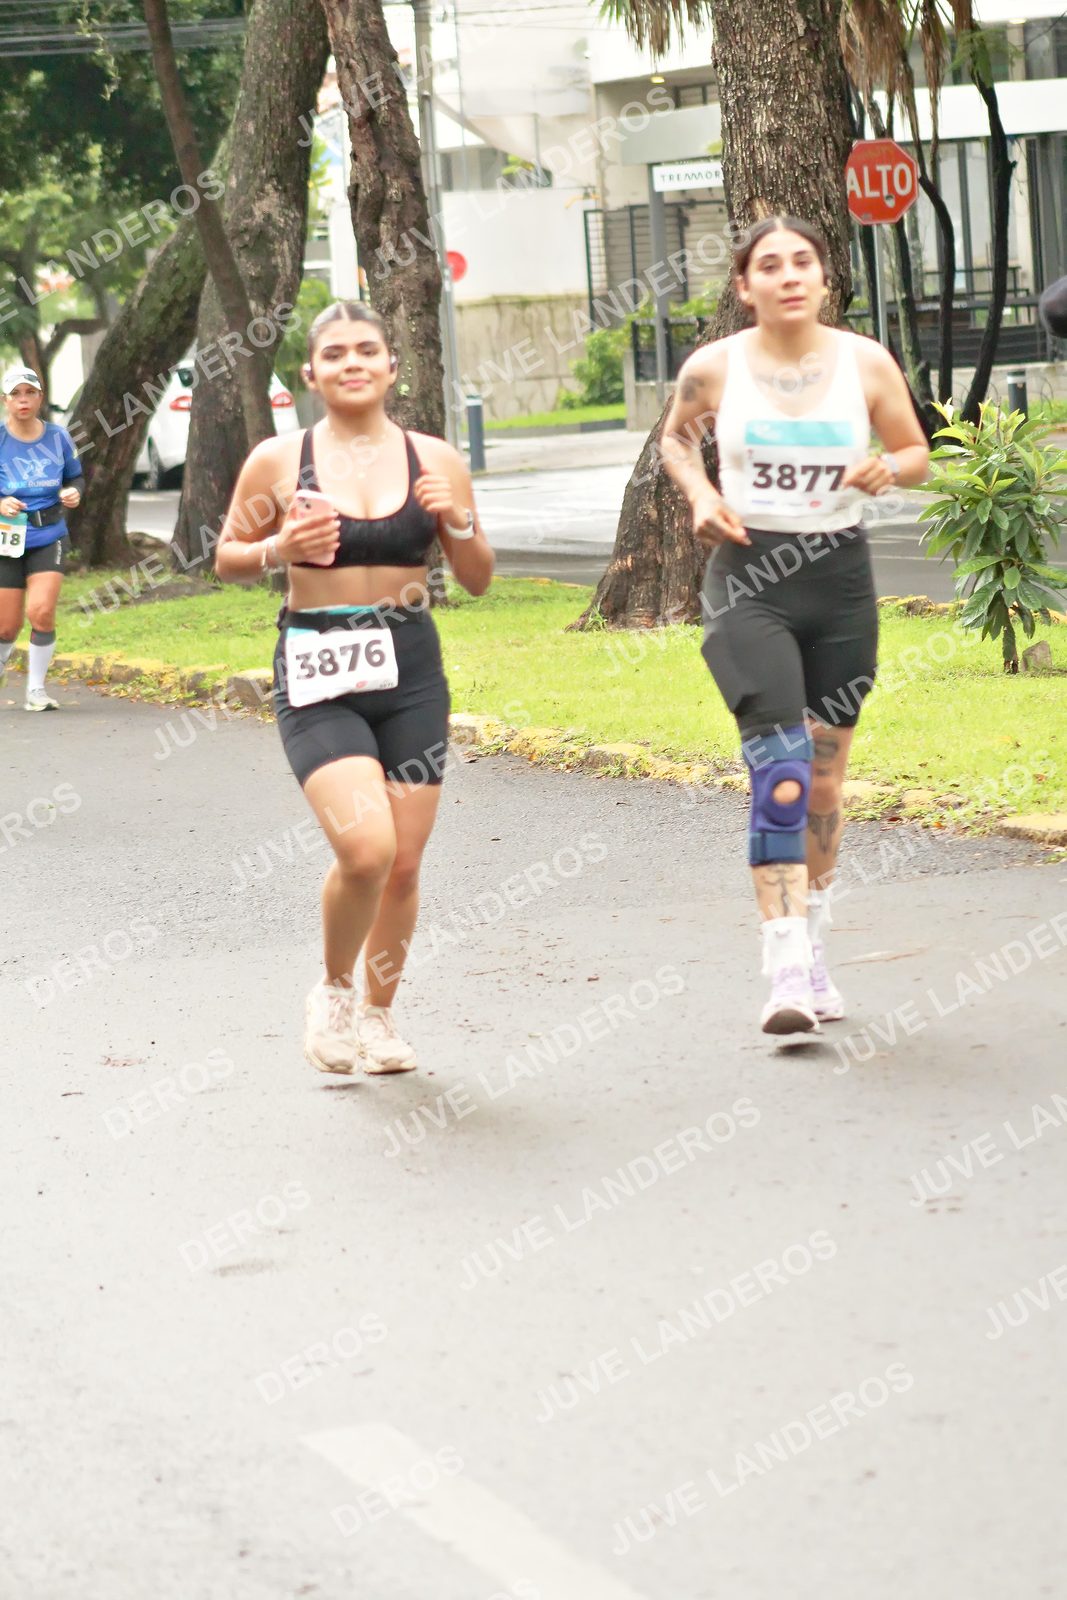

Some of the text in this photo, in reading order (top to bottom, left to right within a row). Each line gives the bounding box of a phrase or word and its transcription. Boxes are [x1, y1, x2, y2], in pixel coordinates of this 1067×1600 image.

[847, 163, 912, 200] ALTO
[752, 463, 847, 492] 3877
[295, 639, 386, 680] 3876
